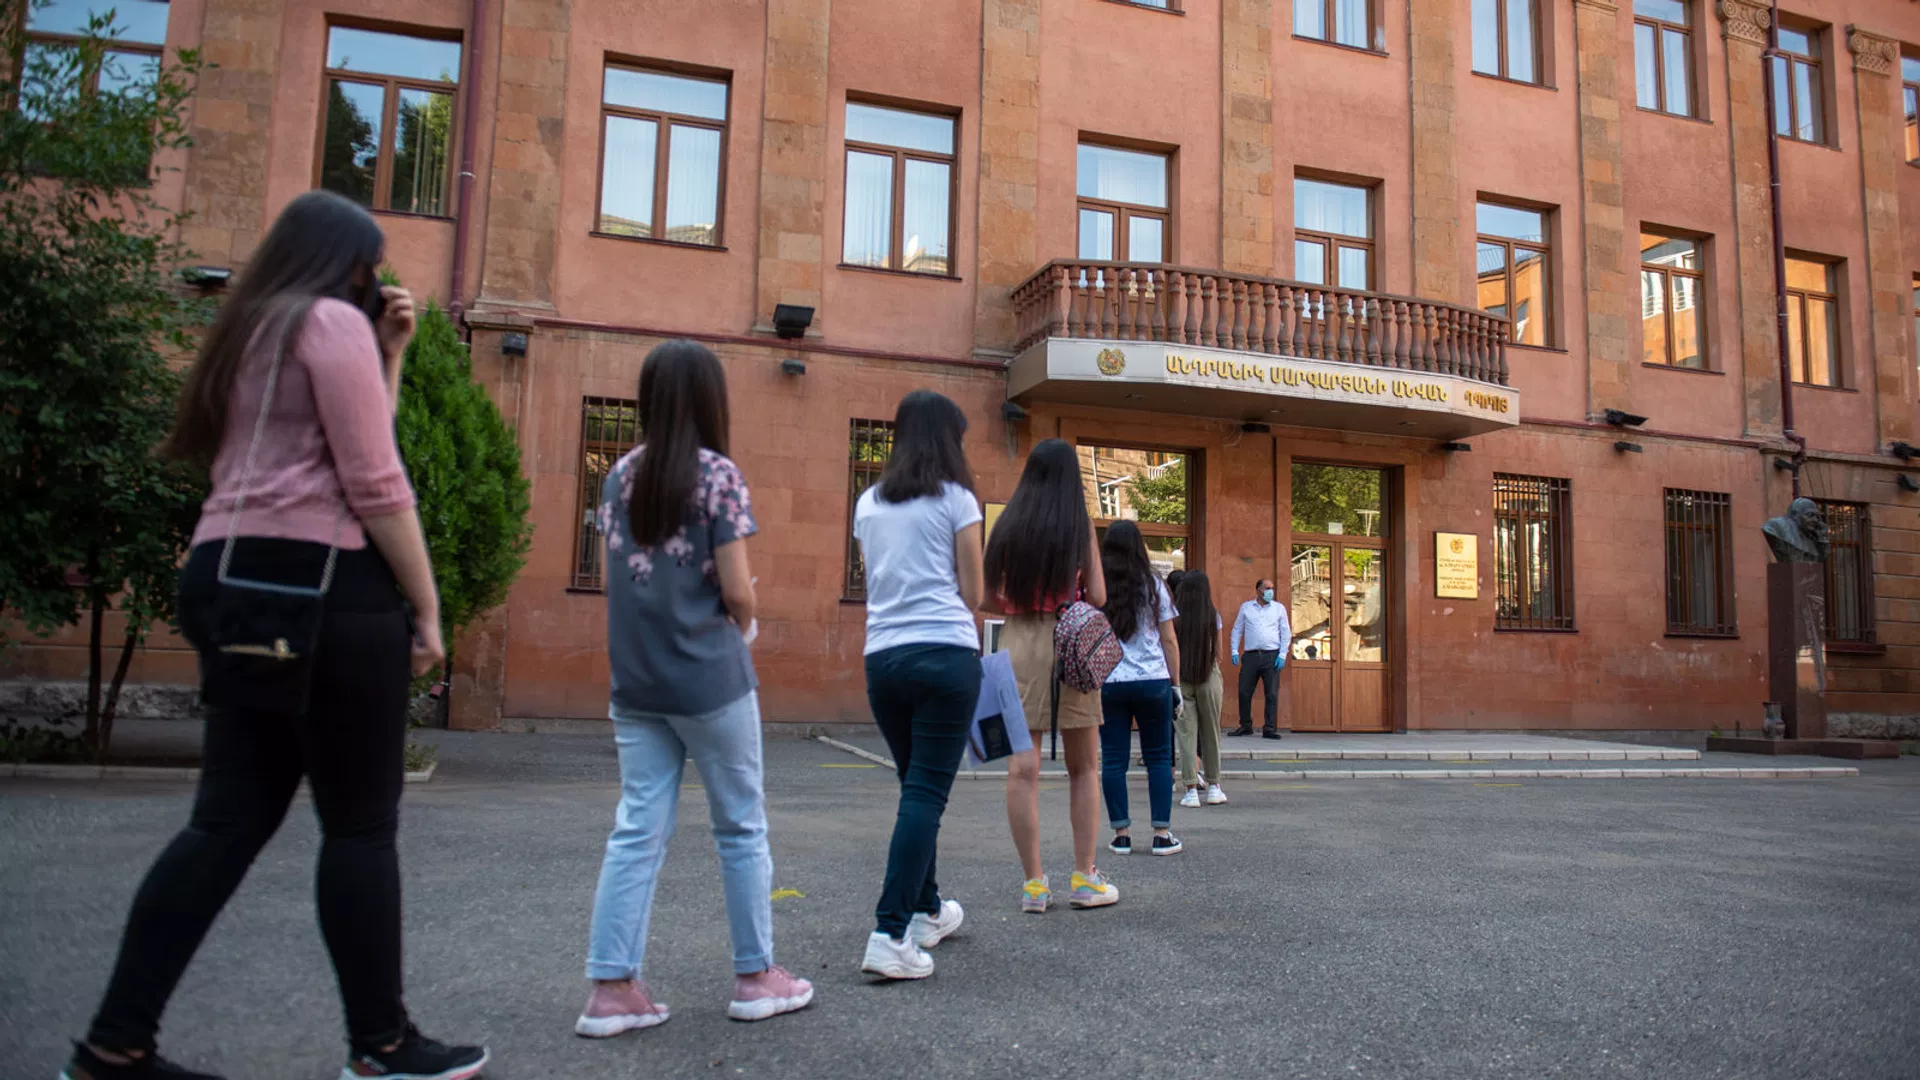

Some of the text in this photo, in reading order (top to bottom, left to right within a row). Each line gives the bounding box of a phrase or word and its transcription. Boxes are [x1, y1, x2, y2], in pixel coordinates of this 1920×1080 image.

[1167, 355, 1508, 413] ԱՆԴՐԱՆԻԿ ՄԱՐԳԱՐՅԱՆԻ ԱՆՎԱՆ ԴՊՐՈՑ
